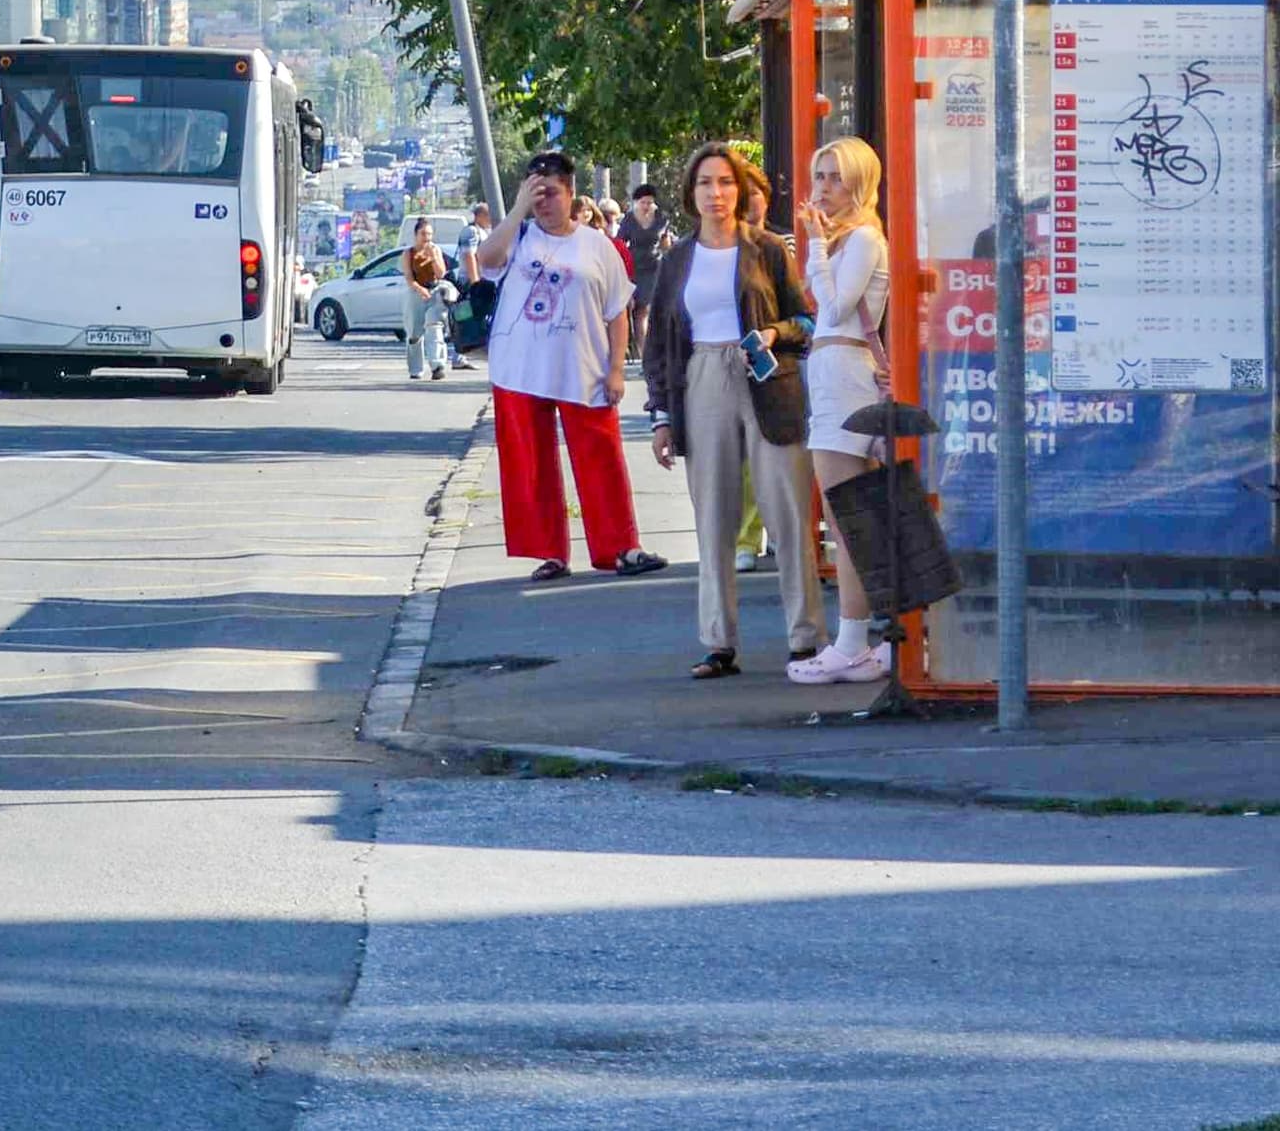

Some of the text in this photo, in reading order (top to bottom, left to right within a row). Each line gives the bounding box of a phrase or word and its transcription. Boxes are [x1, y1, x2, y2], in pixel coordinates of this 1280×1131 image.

[945, 114, 987, 127] 2025
[25, 189, 67, 207] 6067
[945, 399, 1134, 427] МООДЕЖЬ!
[945, 431, 1057, 455] СПТ!
